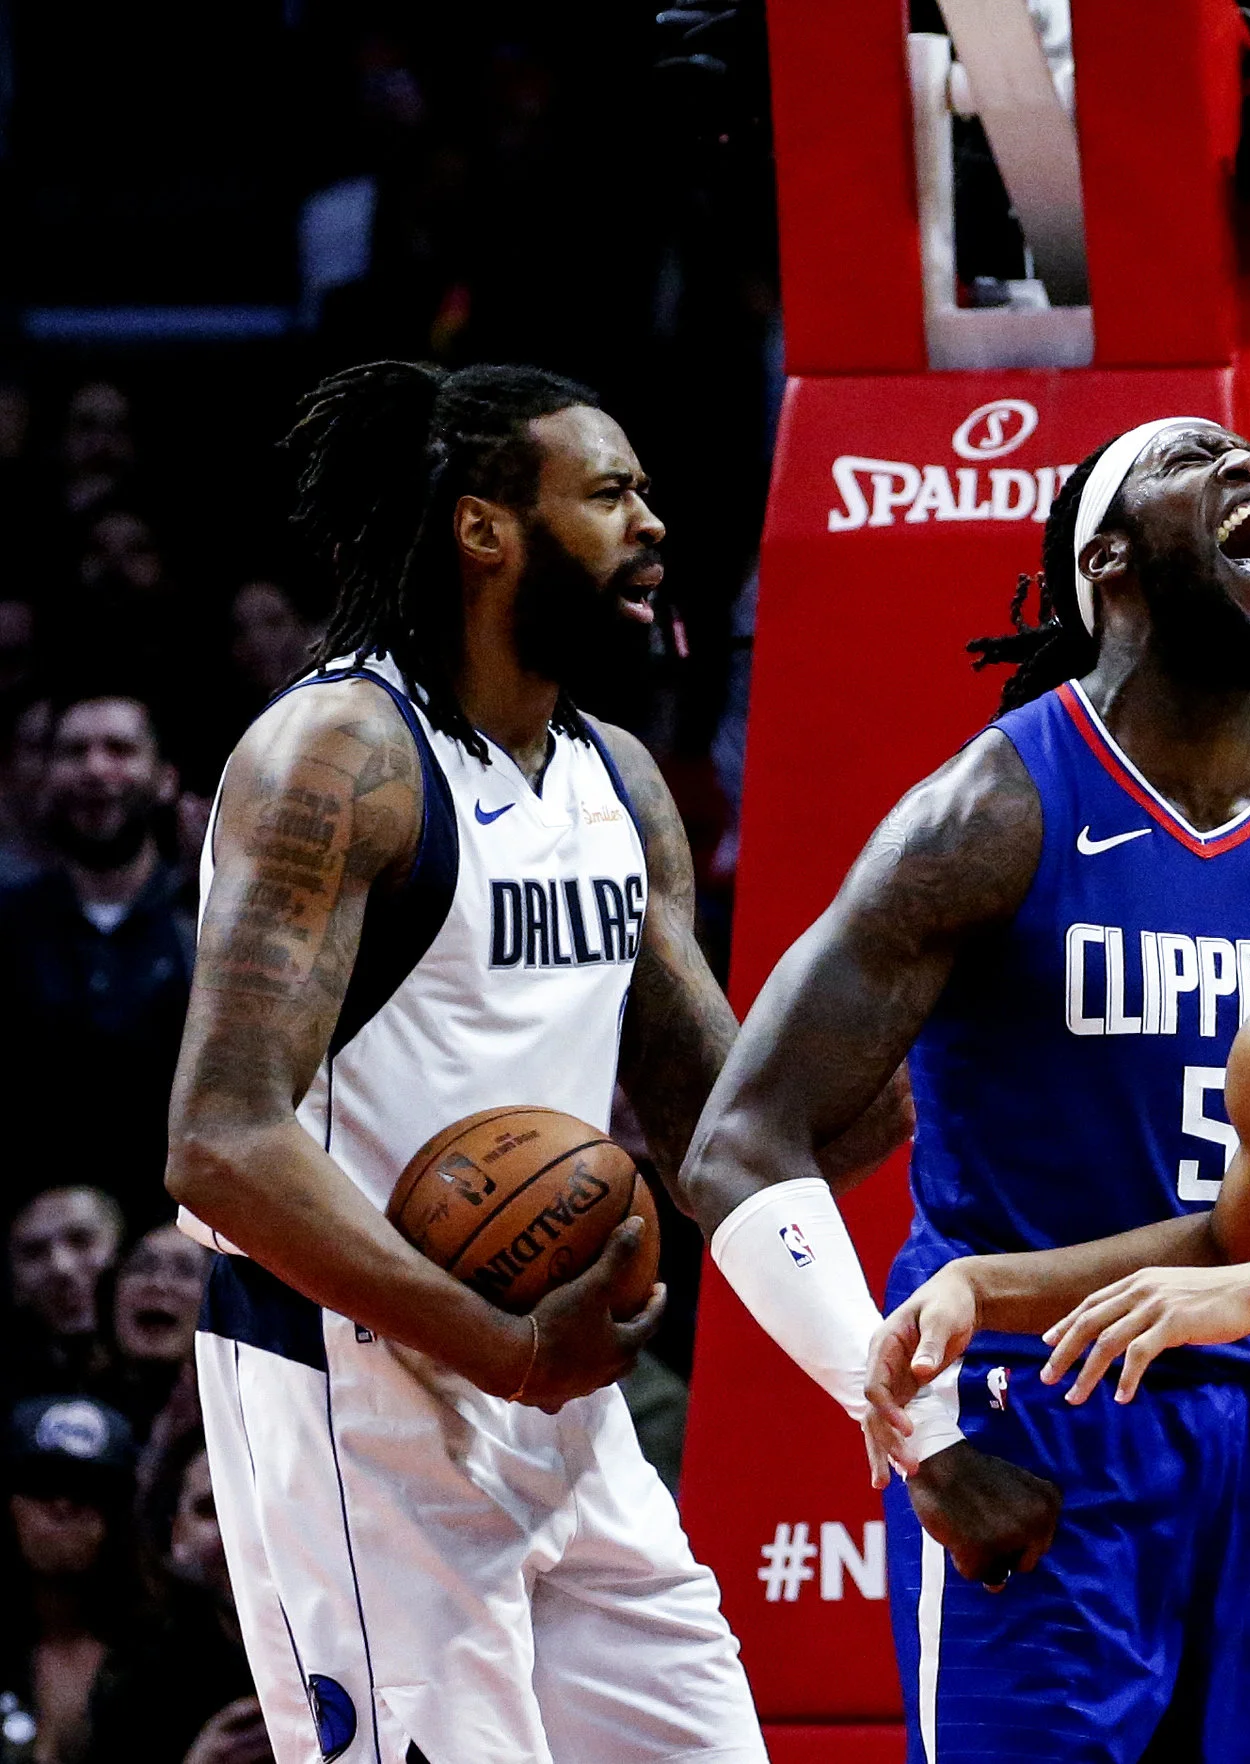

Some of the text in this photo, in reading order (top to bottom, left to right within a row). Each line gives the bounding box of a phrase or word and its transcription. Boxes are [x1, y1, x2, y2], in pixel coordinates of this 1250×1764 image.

[828, 455, 1076, 532] SPALDI
[488, 872, 645, 971] DALLAS
[1178, 1066, 1240, 1201] 5
[757, 1520, 887, 1602] #N
